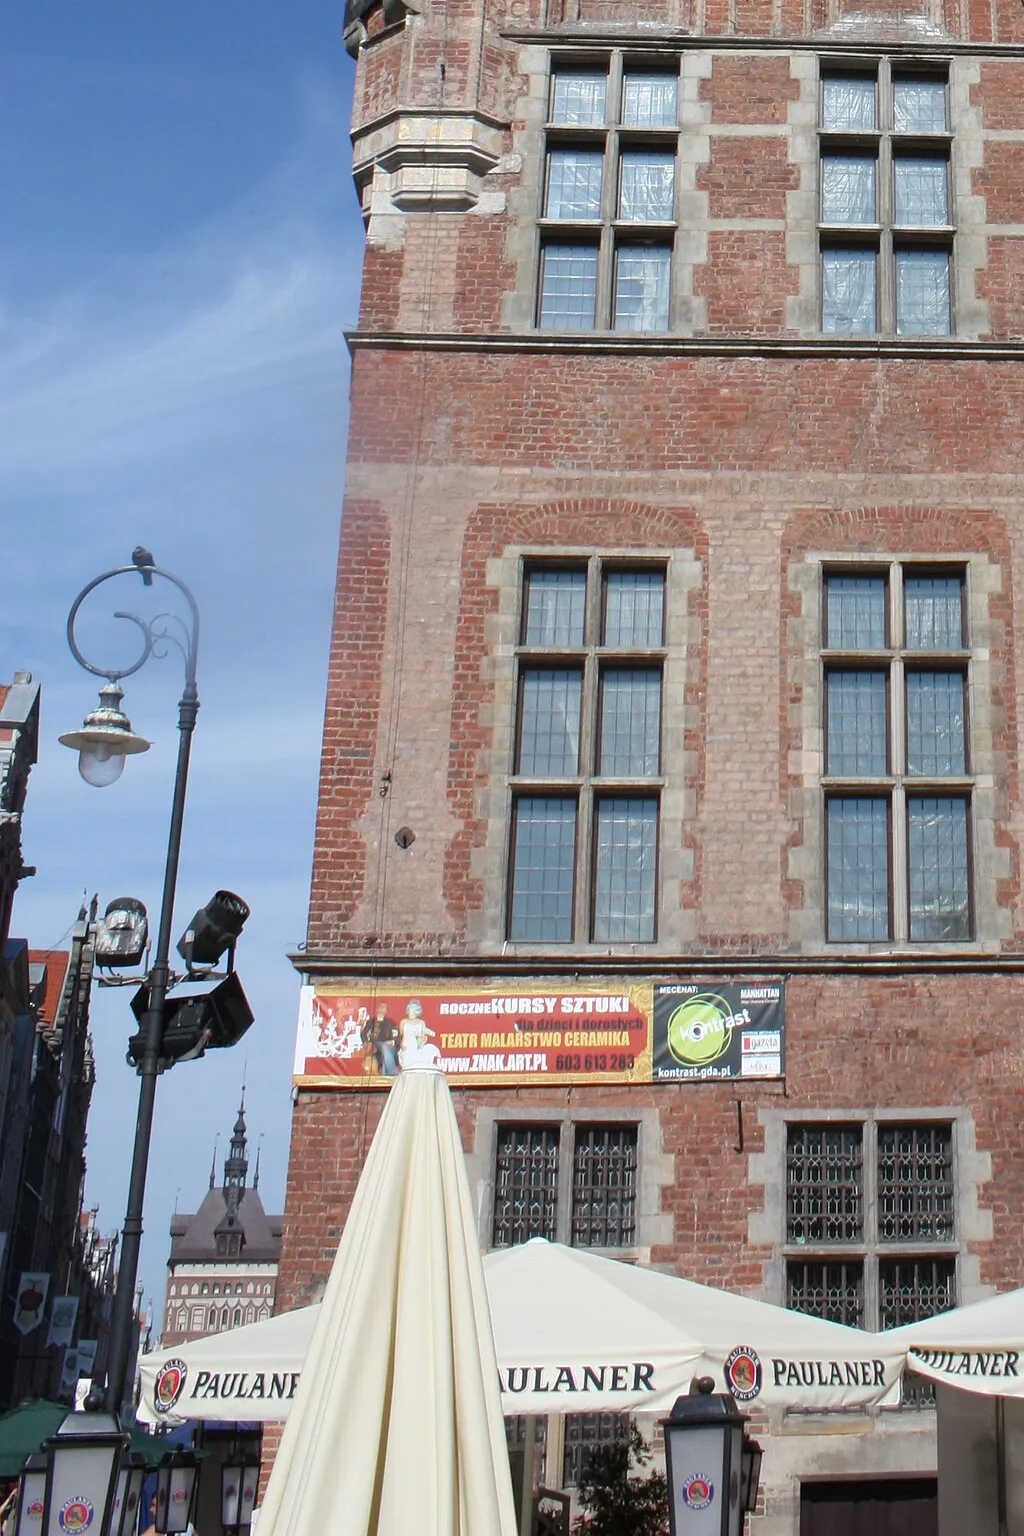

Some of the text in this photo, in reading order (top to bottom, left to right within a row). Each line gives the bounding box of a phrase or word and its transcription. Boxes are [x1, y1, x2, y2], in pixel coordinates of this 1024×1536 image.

[660, 986, 698, 994] MECENAT:
[740, 988, 780, 998] MANHATTAN
[440, 996, 629, 1015] ROCZNE KURSY SZTUKI
[536, 1018, 573, 1031] dzieci
[680, 1009, 751, 1042] kontrast
[440, 1031, 631, 1049] TEATR MALARSTWO CERAMIKA
[555, 1055, 581, 1071] 603
[584, 1055, 607, 1070] 613
[610, 1053, 636, 1070] 283
[658, 1066, 731, 1078] kontrast.gda.pl
[727, 1346, 759, 1367] PAULANER
[498, 1362, 657, 1393] ULANER
[771, 1358, 886, 1387] PAULANER
[189, 1372, 301, 1399] PAULANE
